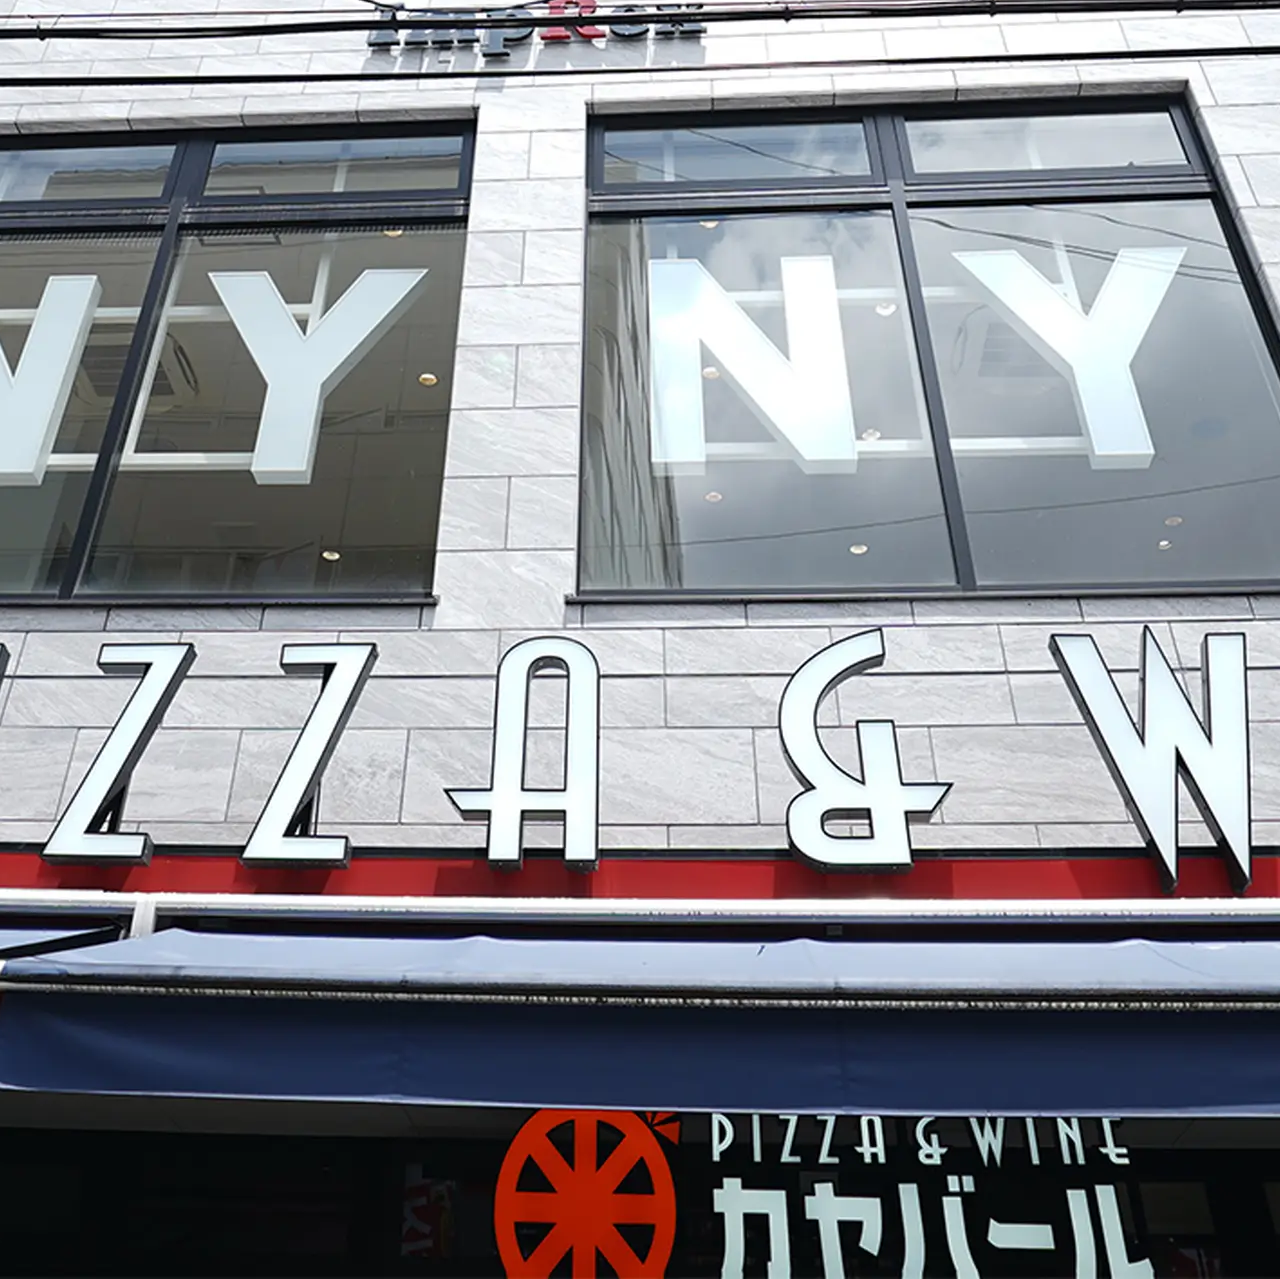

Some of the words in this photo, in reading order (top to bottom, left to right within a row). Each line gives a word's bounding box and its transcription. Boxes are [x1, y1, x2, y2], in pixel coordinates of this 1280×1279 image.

[778, 626, 952, 875] &
[711, 1112, 887, 1165] PIZZA
[914, 1116, 949, 1166] &
[968, 1115, 1131, 1168] WINE
[711, 1175, 1156, 1279] カヤバール
